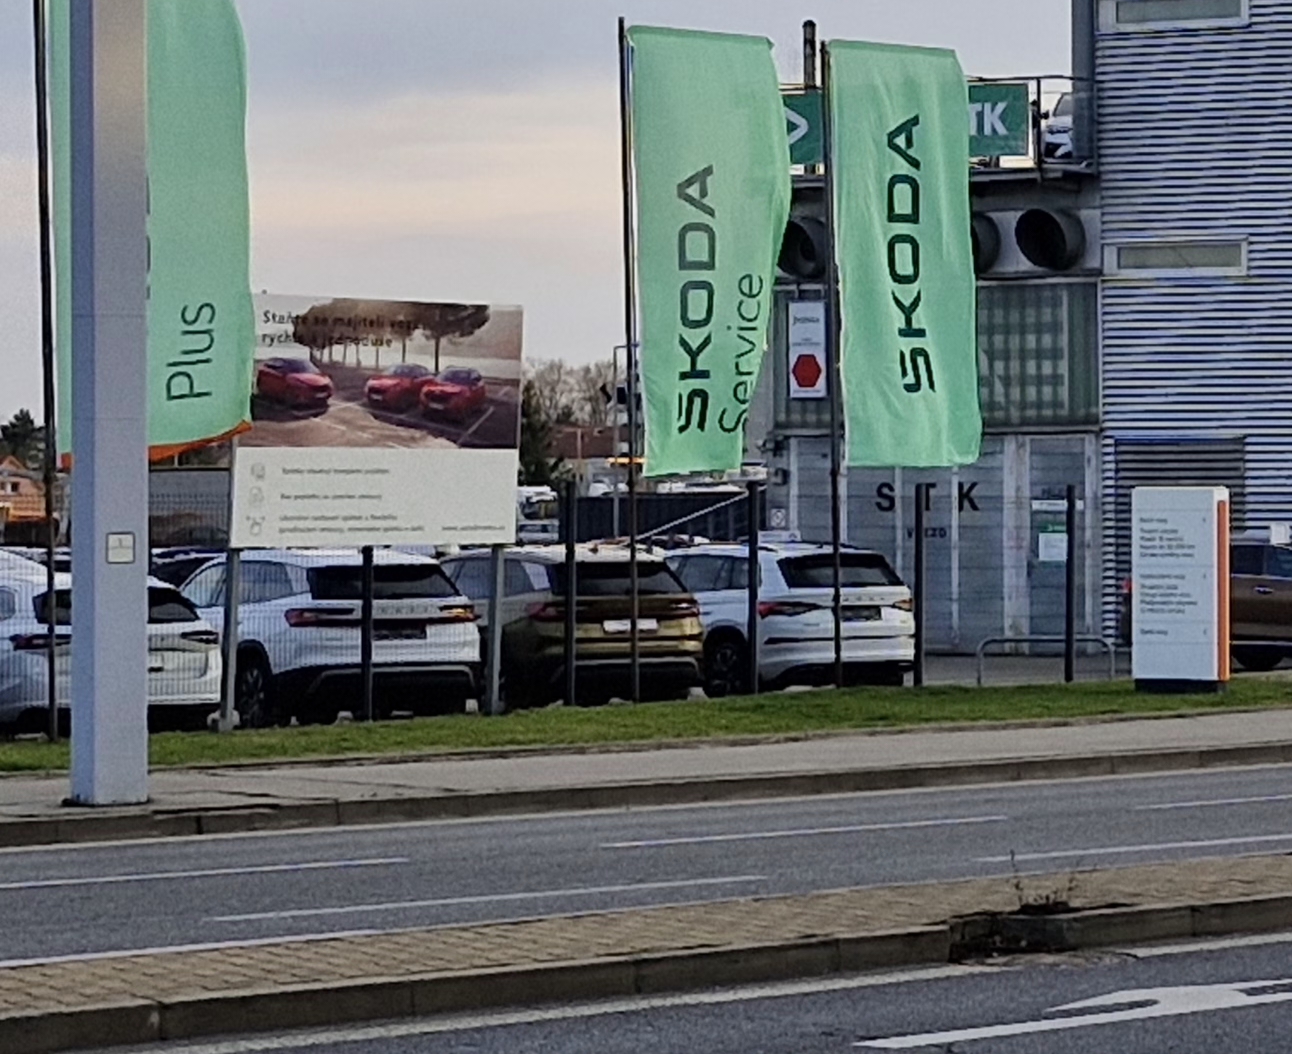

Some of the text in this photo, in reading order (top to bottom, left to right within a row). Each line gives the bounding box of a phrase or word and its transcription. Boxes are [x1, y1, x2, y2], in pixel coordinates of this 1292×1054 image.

[969, 101, 1008, 136] TK
[677, 164, 717, 433] ŠKODA
[887, 114, 936, 394] ŠKODA
[167, 301, 216, 402] Plus
[719, 272, 764, 434] Service
[907, 528, 947, 539] VEZD
